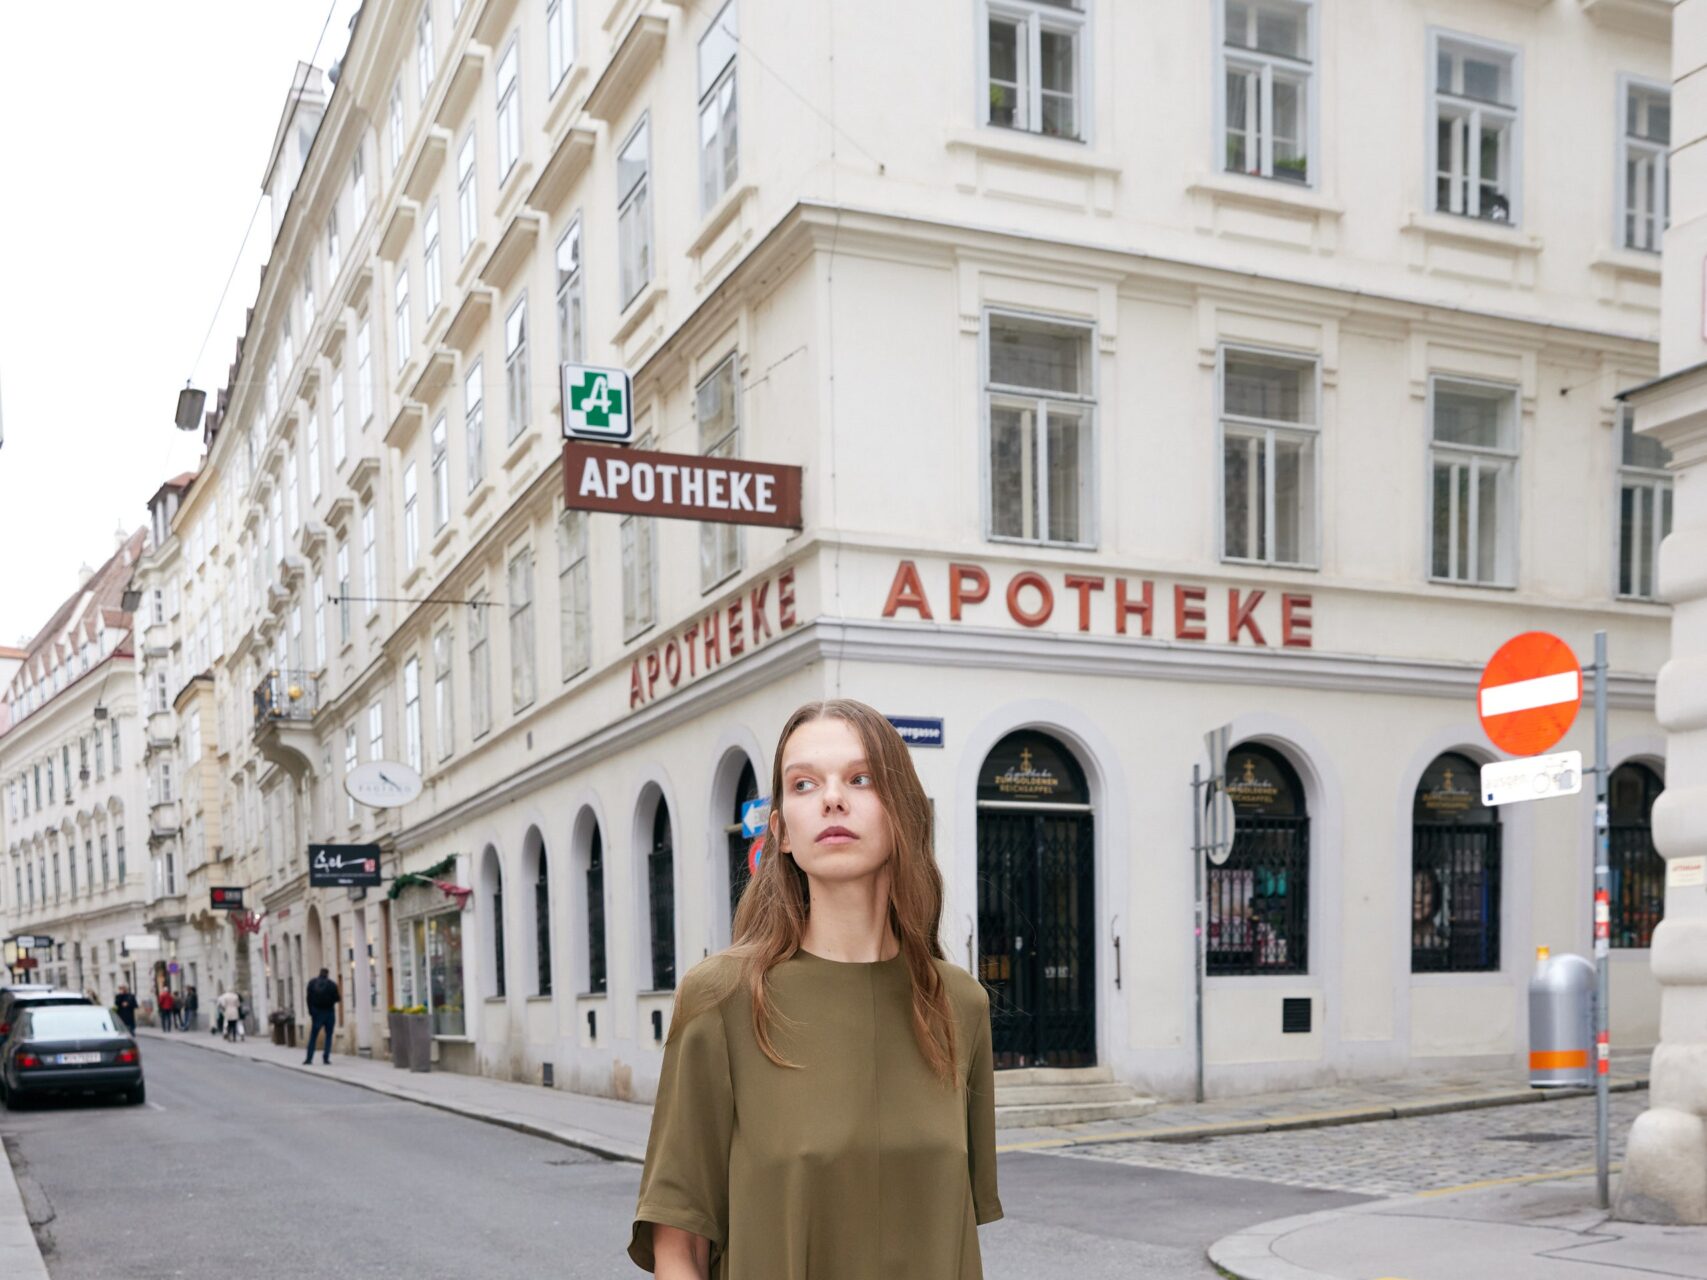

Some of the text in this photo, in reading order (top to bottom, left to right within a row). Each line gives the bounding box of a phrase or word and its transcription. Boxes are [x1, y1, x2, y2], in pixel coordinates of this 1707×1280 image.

[579, 457, 777, 513] APOTHEKE
[629, 566, 797, 709] APOTHEKE
[881, 560, 1313, 648] APOTHEKE
